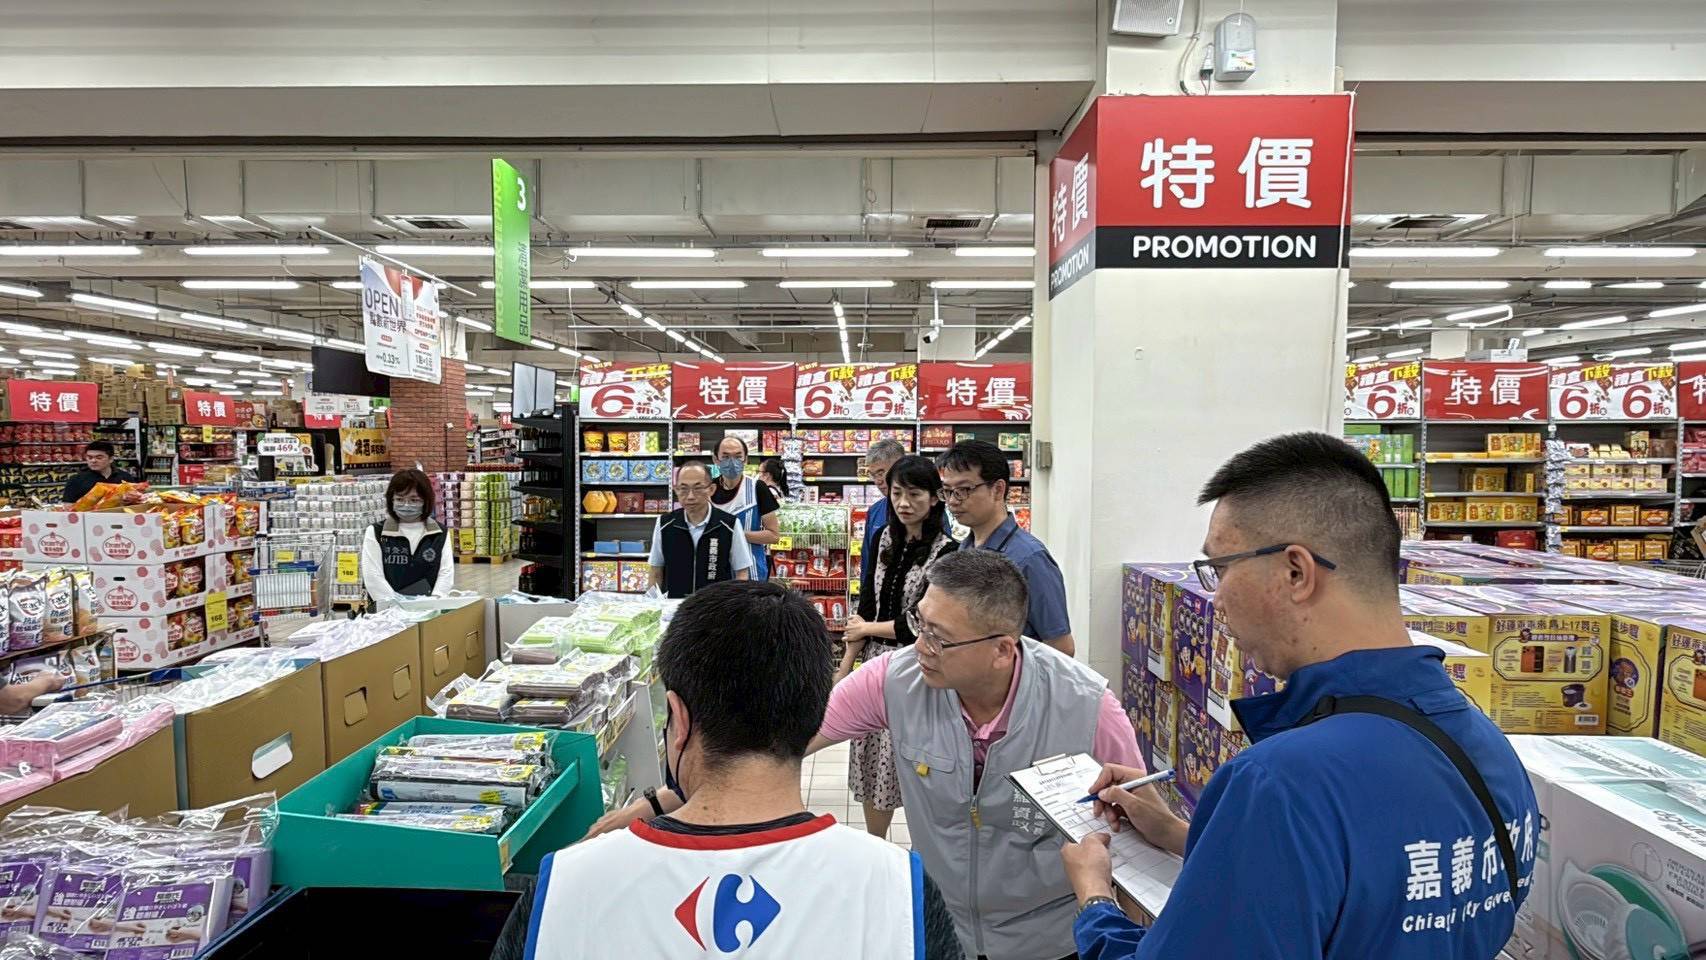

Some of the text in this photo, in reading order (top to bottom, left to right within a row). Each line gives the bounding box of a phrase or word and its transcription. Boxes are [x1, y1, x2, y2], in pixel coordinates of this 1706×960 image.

[1140, 136, 1314, 209] 特價
[517, 177, 526, 211] 3
[1052, 152, 1089, 248] 特價
[1133, 234, 1317, 259] PROMOTION
[1050, 243, 1090, 291] PROMOTION
[365, 287, 399, 317] OPEN
[29, 391, 79, 412] 特價
[699, 376, 768, 404] 特價
[946, 377, 1016, 406] 特價
[1450, 375, 1521, 405] 特價
[197, 400, 227, 417] 特價
[707, 537, 719, 580] 嘉義市政府
